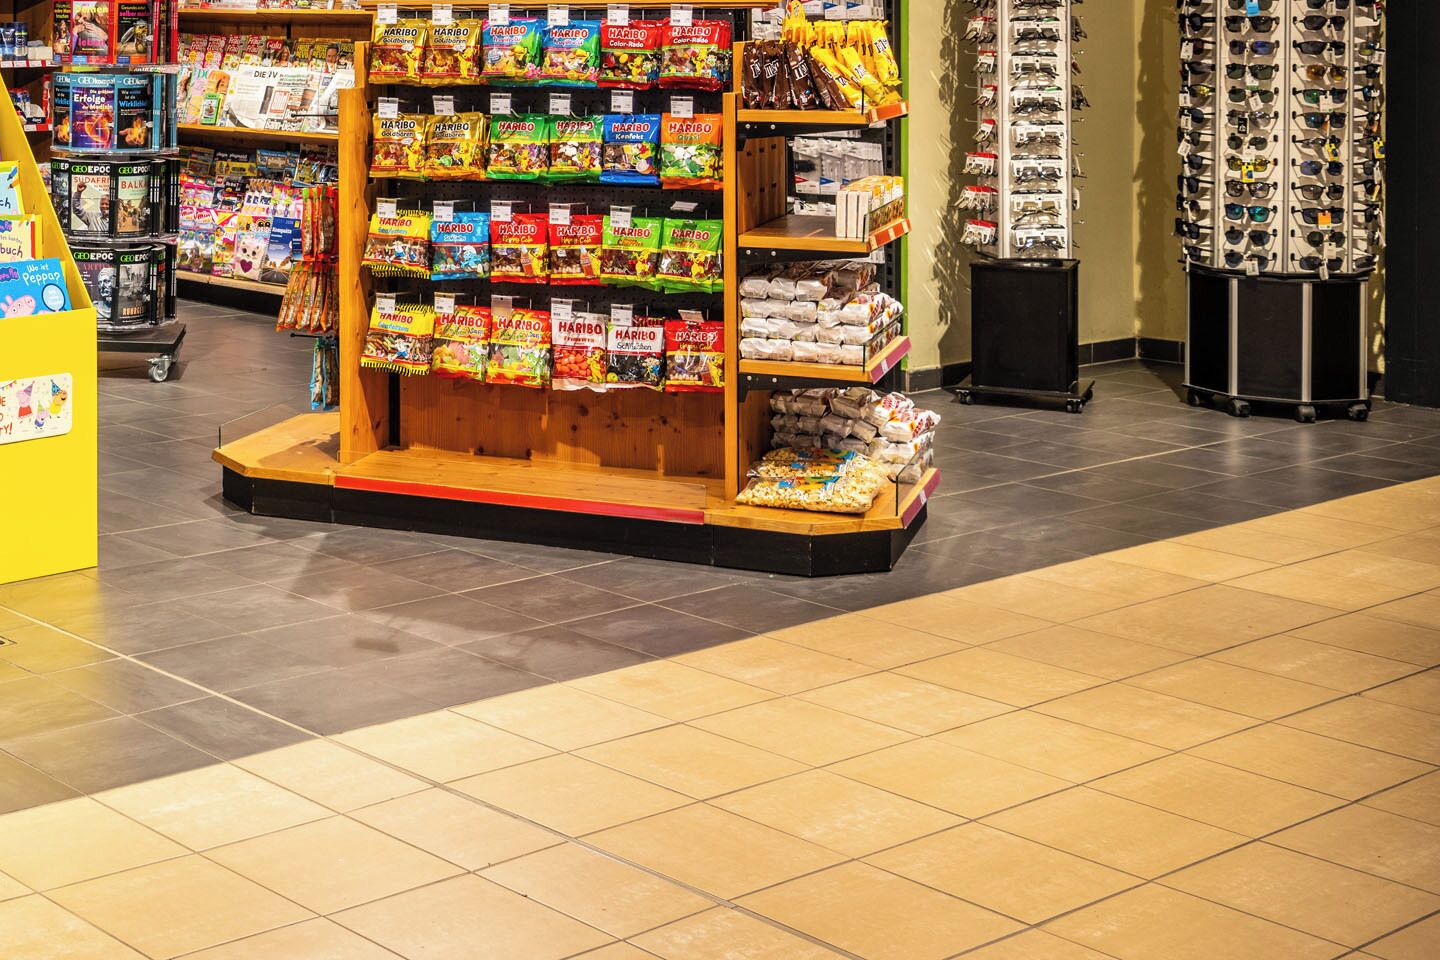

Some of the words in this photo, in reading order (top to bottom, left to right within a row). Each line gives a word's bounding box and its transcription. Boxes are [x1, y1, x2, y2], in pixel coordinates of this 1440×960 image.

[383, 28, 418, 37] HARIBO
[433, 28, 469, 37] HARIBO
[490, 25, 527, 36] HARIBO
[550, 28, 589, 39] HARIBO
[608, 27, 648, 40] HARIBO
[672, 26, 712, 37] HARIBO
[383, 37, 415, 45] Goldbären
[433, 37, 467, 45] Goldbären
[609, 40, 644, 48] Color-Rado
[673, 36, 709, 44] Color-Rado
[266, 41, 282, 50] Gala
[253, 70, 266, 79] DIE
[73, 94, 106, 104] Erfolge
[380, 121, 416, 130] HARIBO
[434, 123, 470, 133] HARIBO
[498, 121, 535, 132] HARIBO
[612, 122, 651, 133] HARIBO
[668, 122, 713, 134] HARIBO
[615, 133, 645, 141] Konfekt
[71, 165, 88, 173] GEO
[118, 166, 133, 174] GEO
[378, 217, 413, 227] HARIBO
[437, 223, 474, 234] HARIBO
[498, 225, 537, 235] HARIBO
[557, 226, 596, 236] HARIBO
[613, 227, 651, 238] HARIBO
[671, 228, 710, 241] HARIBO
[73, 251, 90, 261] GEO
[120, 254, 135, 263] GEO
[26, 264, 39, 273] Wo
[39, 263, 49, 272] ist
[22, 271, 61, 286] Peppa?
[440, 313, 484, 327] HARIBO
[498, 318, 543, 332] HARIBO
[558, 321, 603, 335] HARIBO
[615, 329, 656, 341] HARIBO
